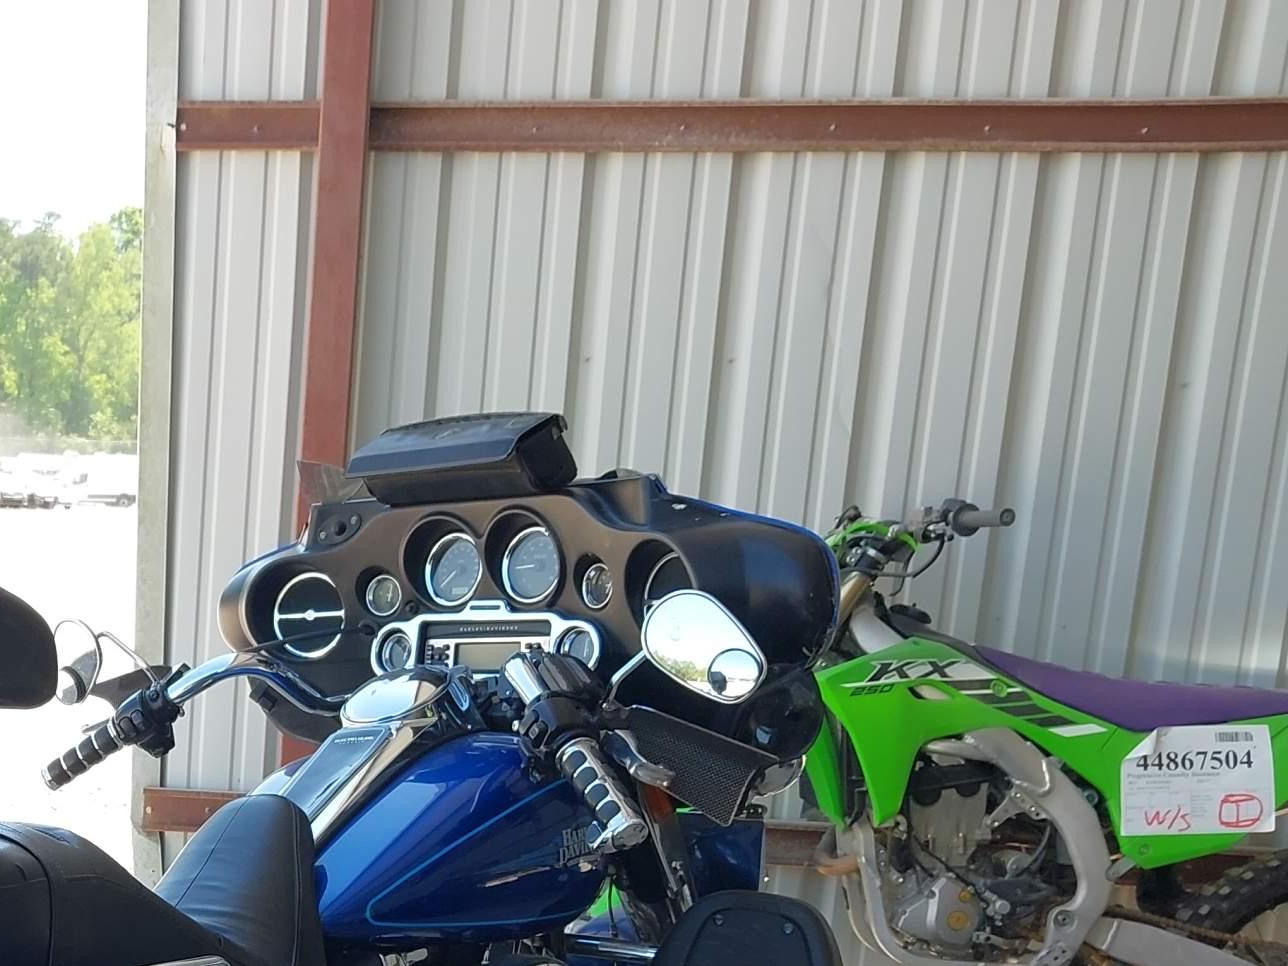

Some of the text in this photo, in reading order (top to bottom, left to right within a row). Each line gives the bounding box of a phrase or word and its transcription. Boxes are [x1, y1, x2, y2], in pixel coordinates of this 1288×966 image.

[866, 660, 962, 682] KX
[850, 684, 894, 696] 250
[1136, 749, 1254, 771] 44867504
